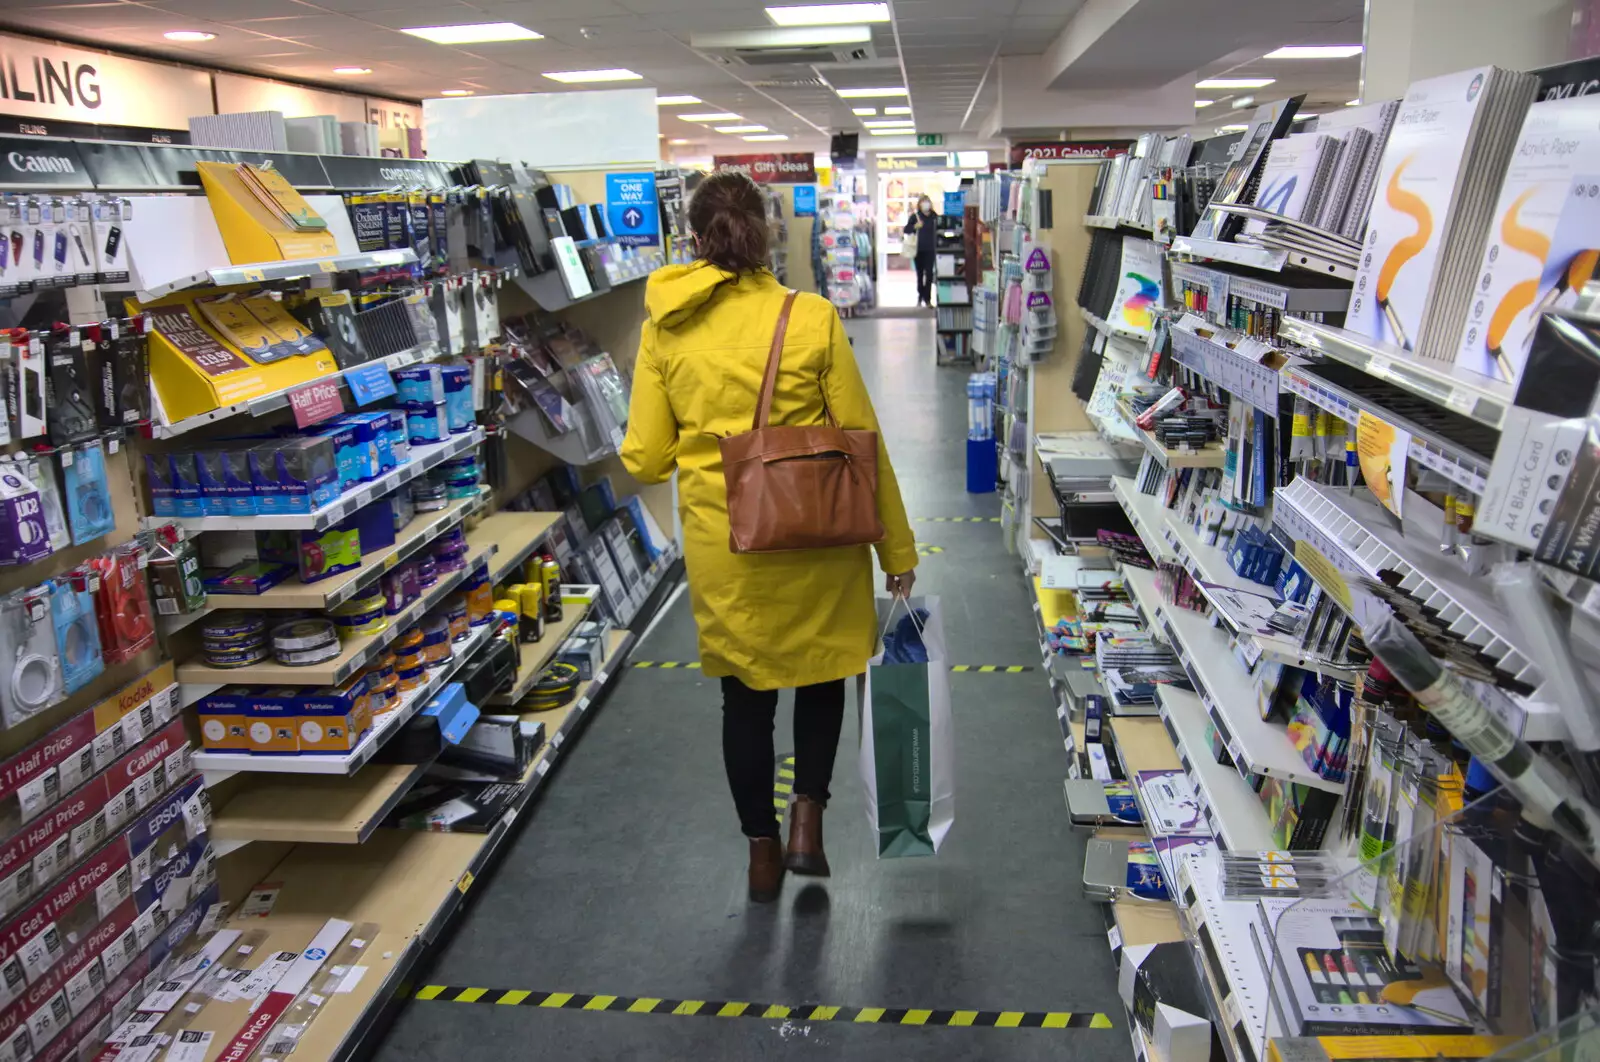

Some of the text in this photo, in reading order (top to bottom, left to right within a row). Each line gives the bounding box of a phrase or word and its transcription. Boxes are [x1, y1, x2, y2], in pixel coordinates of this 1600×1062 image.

[1419, 109, 1440, 122] Paper
[19, 123, 48, 136] FILING
[1024, 148, 1057, 159] 2021
[1518, 137, 1581, 158] Acrylic Paper
[8, 151, 76, 173] Canon
[720, 160, 809, 173] Great Gift Ideas
[379, 167, 425, 181] COMPUTING
[620, 183, 643, 192] ONE
[620, 193, 644, 201] WAY
[355, 211, 383, 222] Oxford
[153, 312, 194, 334] HALF
[167, 330, 215, 348] PRICE
[195, 350, 234, 367] £19.99
[291, 384, 338, 409] Half Price
[1504, 440, 1545, 532] A4 Black Card
[14, 496, 39, 522] juice
[1567, 548, 1586, 571] A4
[118, 681, 154, 712] Kodak
[6, 769, 14, 785] 1
[15, 756, 41, 780] Half
[43, 733, 73, 761] Price
[126, 737, 169, 777] Canon
[20, 834, 29, 848] 1
[28, 822, 54, 848] Half
[56, 800, 86, 827] Price
[149, 796, 187, 835] EPSON
[154, 852, 191, 894] EPSON
[8, 860, 108, 944] 1 Get 1 Half Price
[167, 906, 202, 947] EPSON
[18, 999, 28, 1012] 1
[28, 980, 53, 1003] Get
[62, 949, 87, 976] Half
[88, 921, 116, 951] Price
[35, 1017, 50, 1035] 26
[1342, 1025, 1368, 1036] Acrylic
[223, 1041, 249, 1062] Half
[242, 1013, 272, 1041] Price
